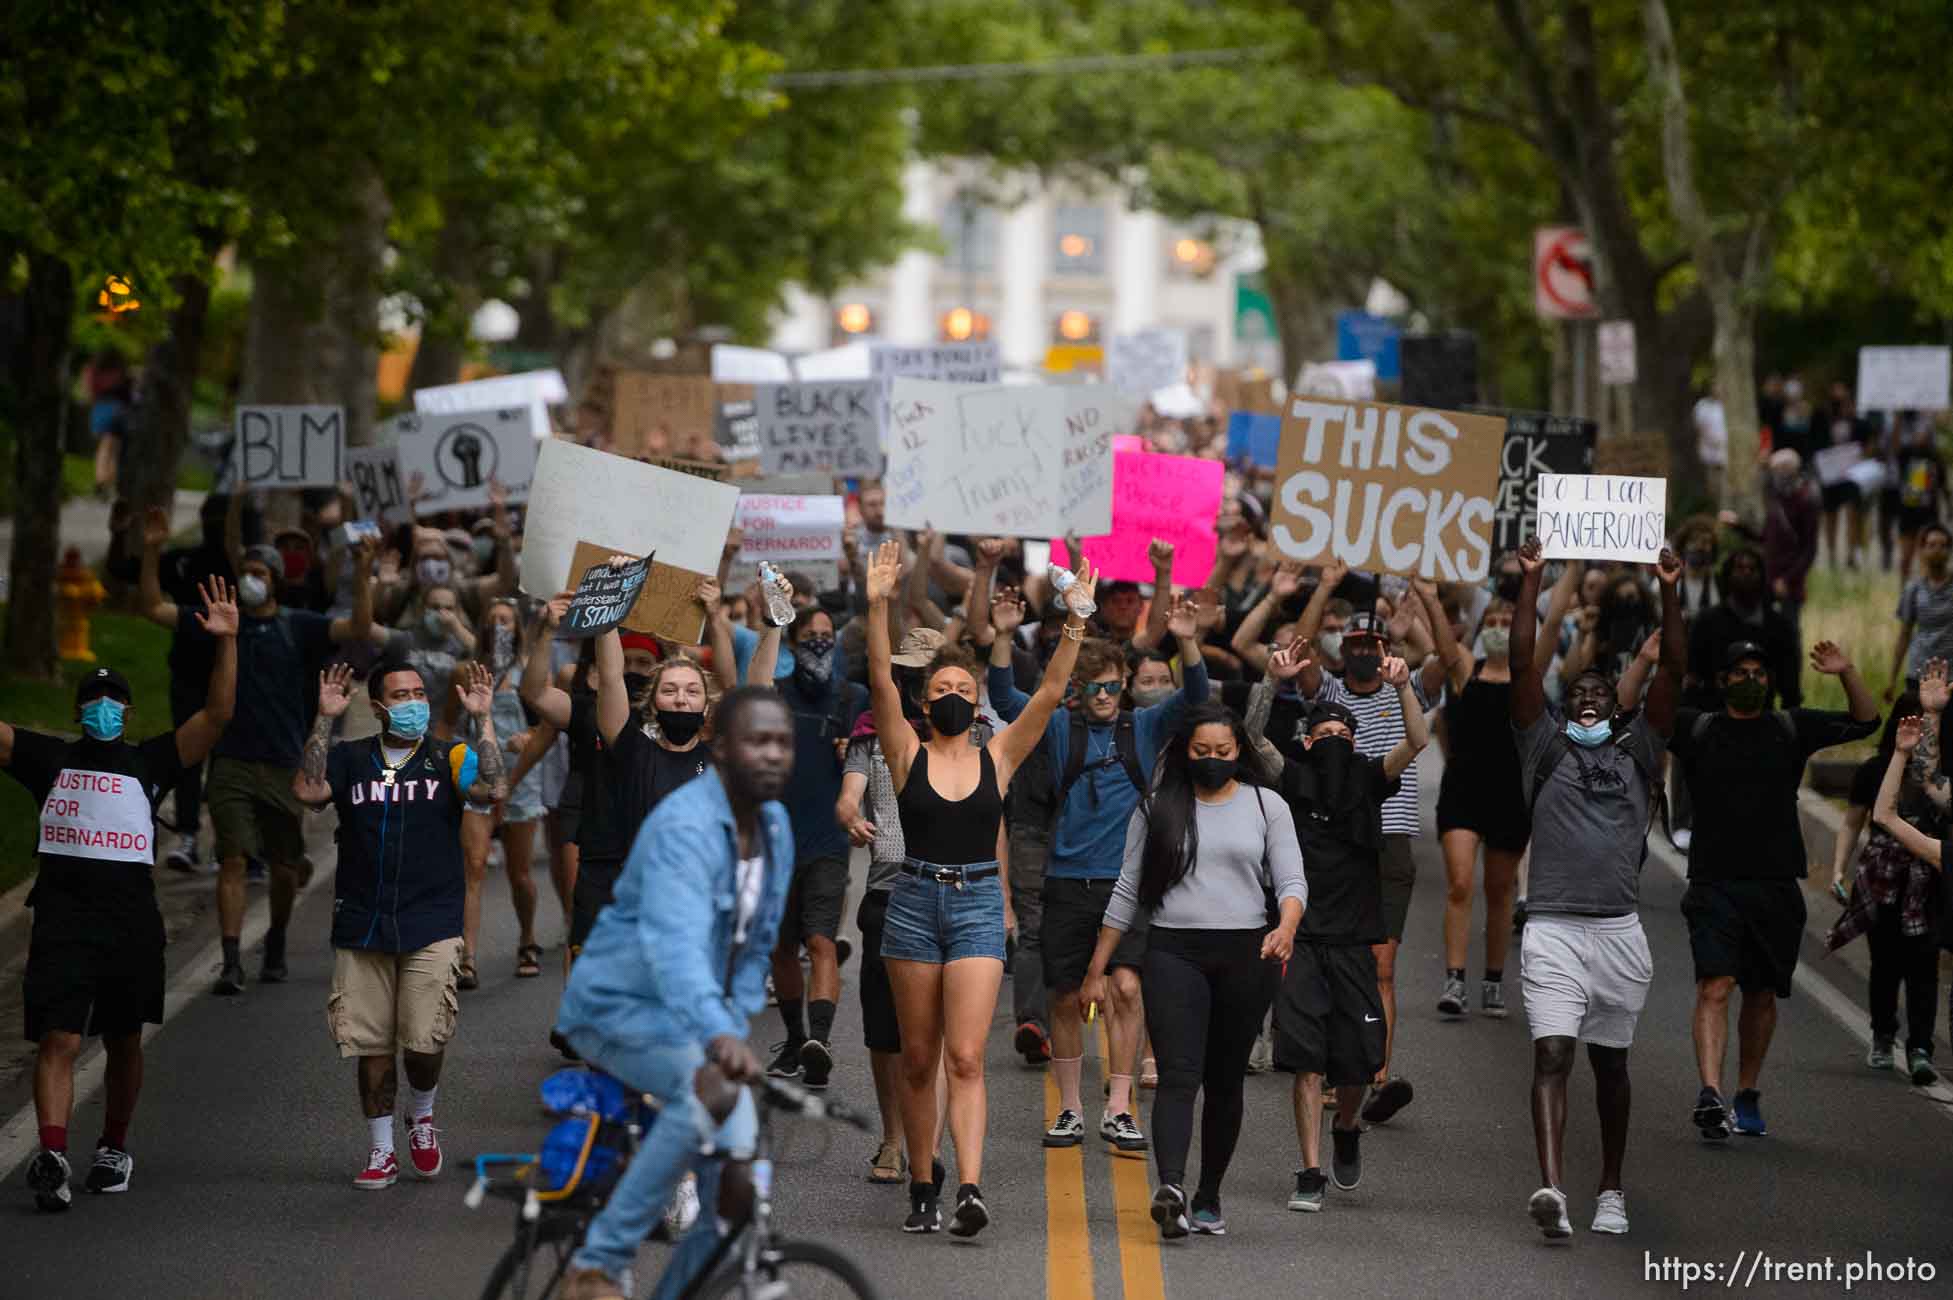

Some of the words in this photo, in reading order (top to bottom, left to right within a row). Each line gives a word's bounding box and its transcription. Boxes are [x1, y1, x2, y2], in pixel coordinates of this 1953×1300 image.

[775, 385, 872, 418] BLACK
[769, 422, 859, 447] LIVES
[1065, 406, 1099, 437] NO
[242, 411, 340, 482] BLM
[1292, 399, 1459, 475] THIS
[778, 449, 873, 471] MATTER
[1502, 435, 1553, 479] CK
[353, 459, 400, 513] BLM
[1540, 477, 1568, 500] DO
[1580, 477, 1594, 501] I
[1607, 479, 1655, 504] LOOK
[739, 496, 806, 512] JUSTICE
[742, 517, 776, 531] FOR
[1272, 470, 1495, 582] SUCKS
[1539, 510, 1665, 551] DANGEROUS?
[743, 536, 833, 553] BERNARDO
[52, 773, 123, 795] JUSTICE
[351, 778, 440, 805] UNITY
[46, 798, 80, 818] FOR
[44, 825, 149, 851] BERNARDO
